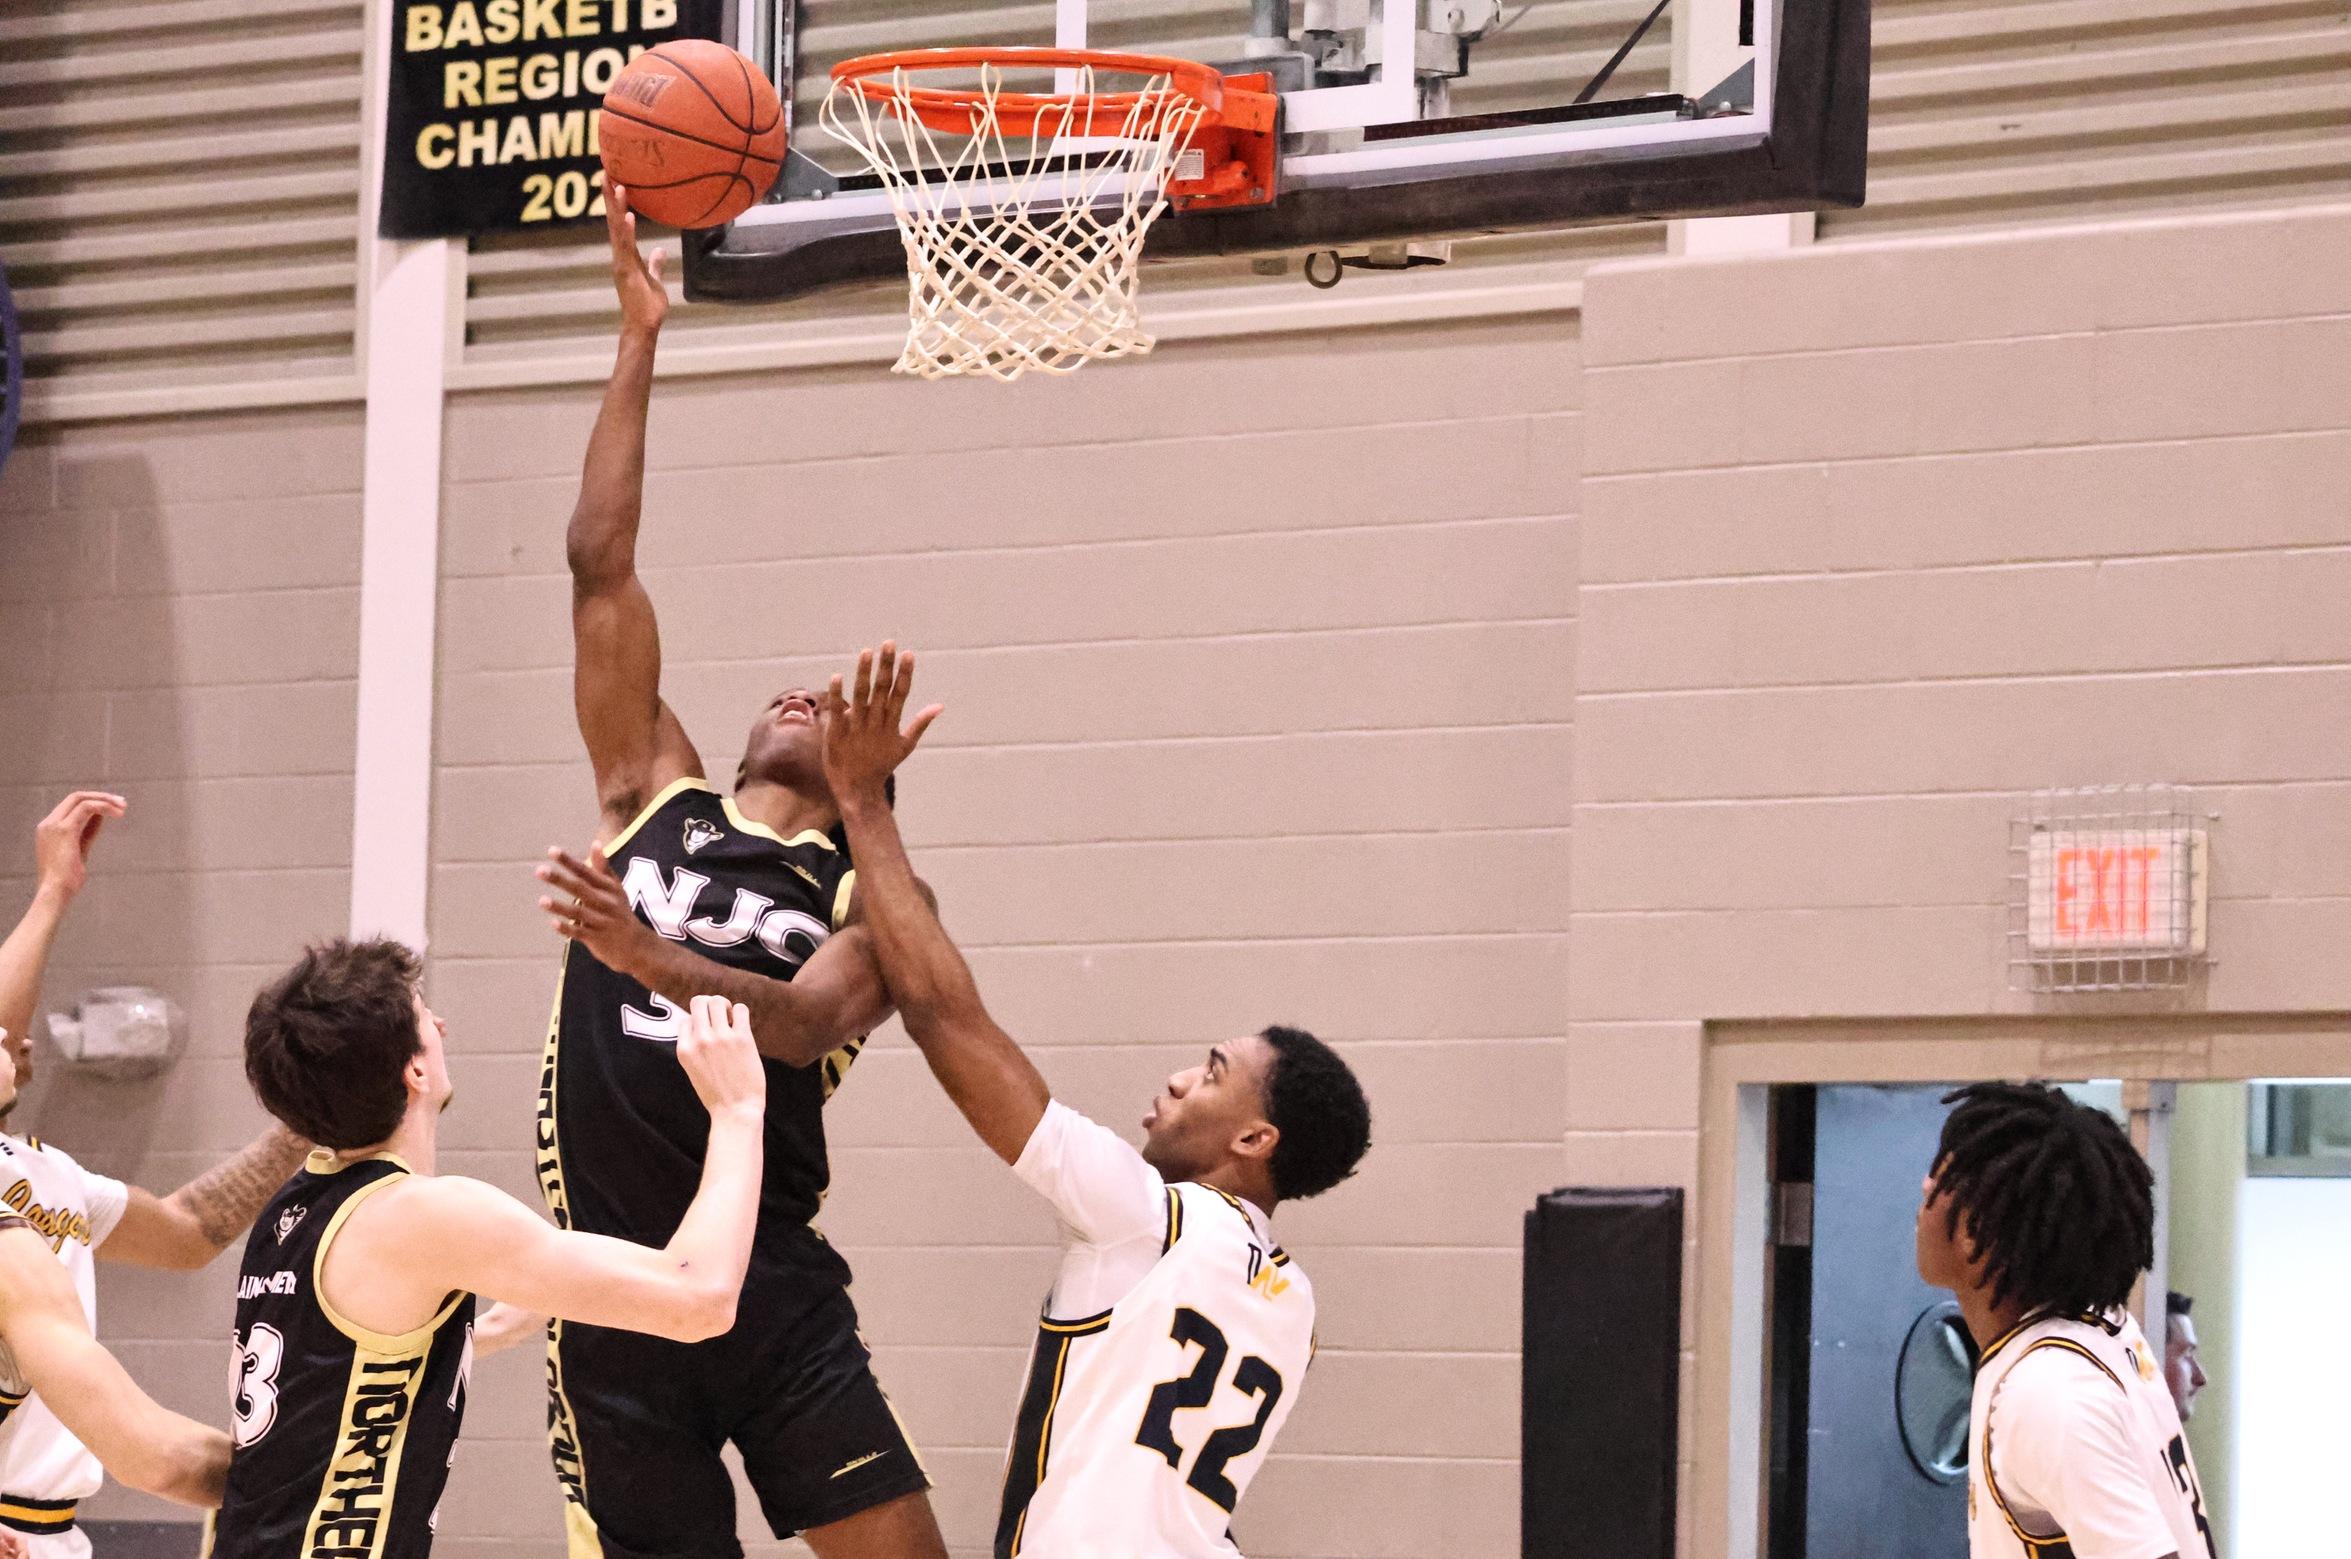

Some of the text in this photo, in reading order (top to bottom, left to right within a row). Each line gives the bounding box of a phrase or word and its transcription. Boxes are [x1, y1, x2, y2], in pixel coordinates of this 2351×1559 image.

[443, 43, 650, 108] REGIO
[2056, 847, 2160, 936] EXIT
[228, 1321, 284, 1451] 3
[1134, 1305, 1284, 1515] 22
[312, 1356, 423, 1559] NORTHE
